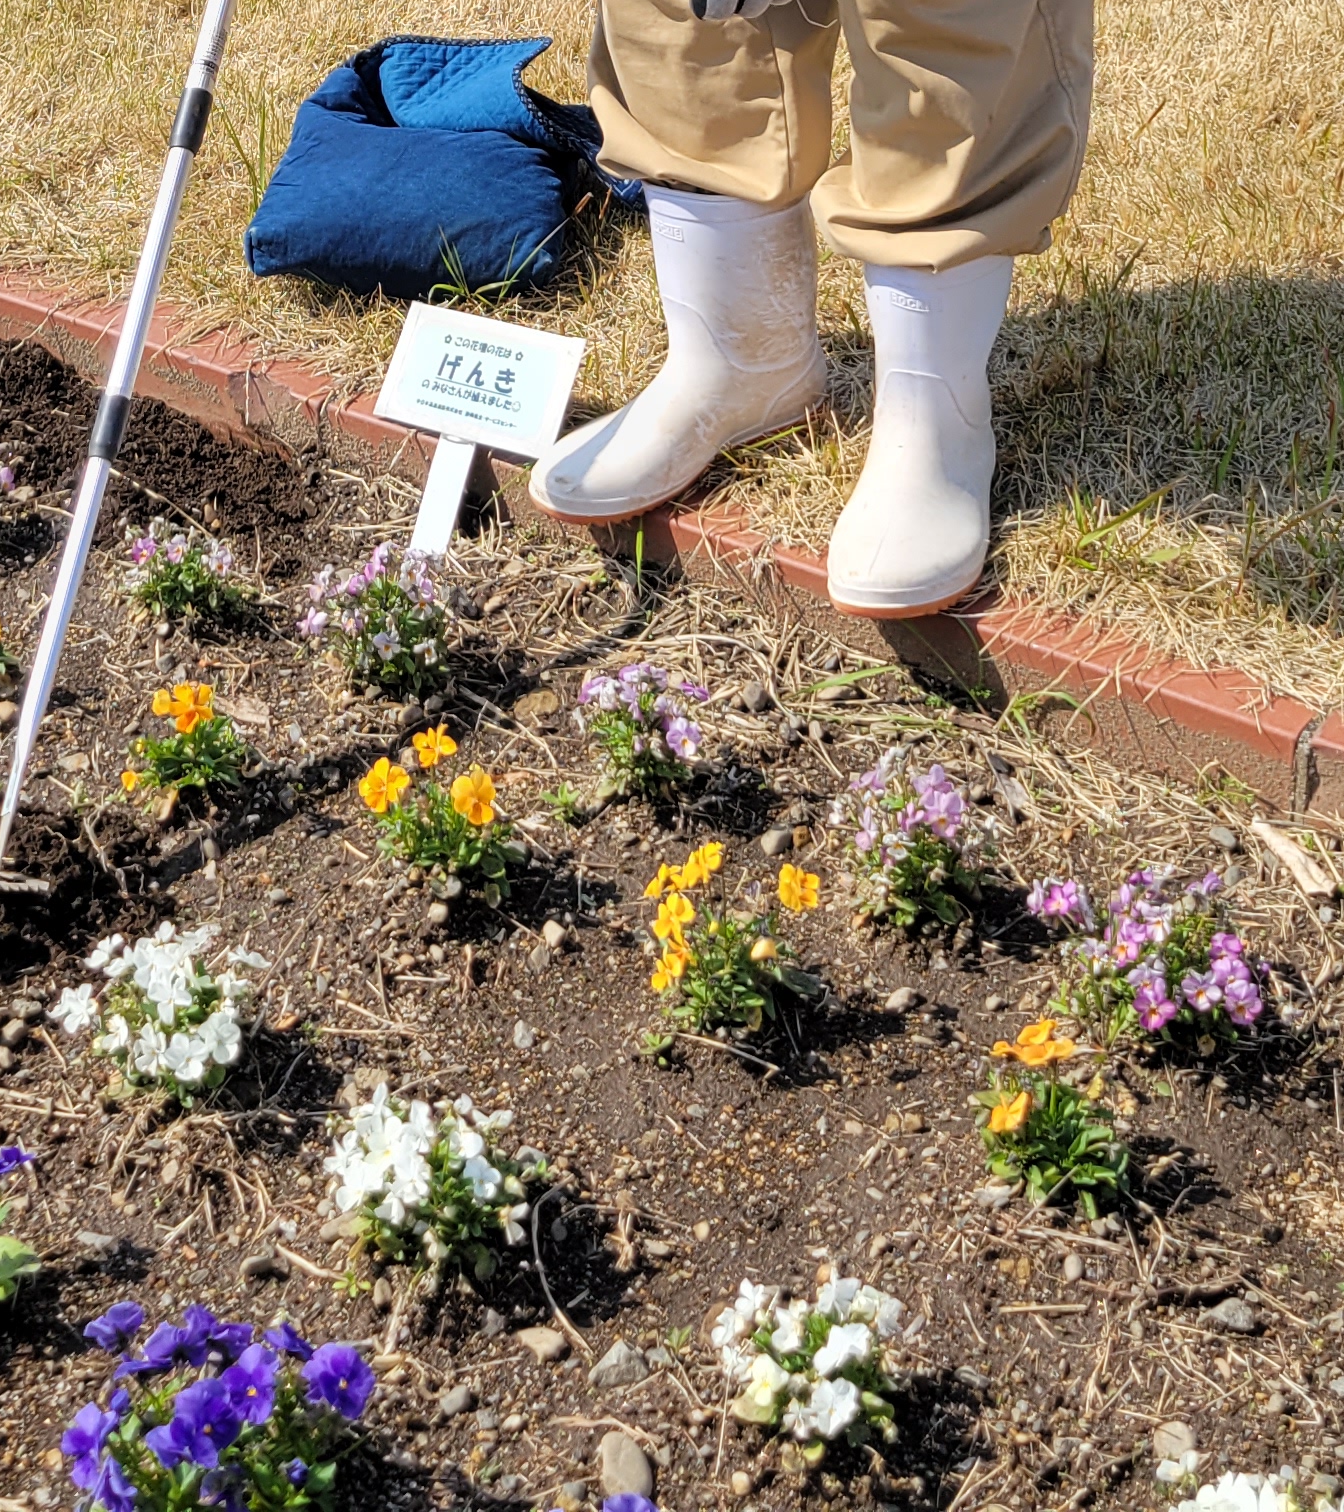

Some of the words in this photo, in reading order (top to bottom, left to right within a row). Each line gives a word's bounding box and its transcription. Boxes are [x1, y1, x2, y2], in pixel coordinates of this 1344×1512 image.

[454, 336, 513, 359] この花壇の花は
[437, 353, 516, 394] げんき
